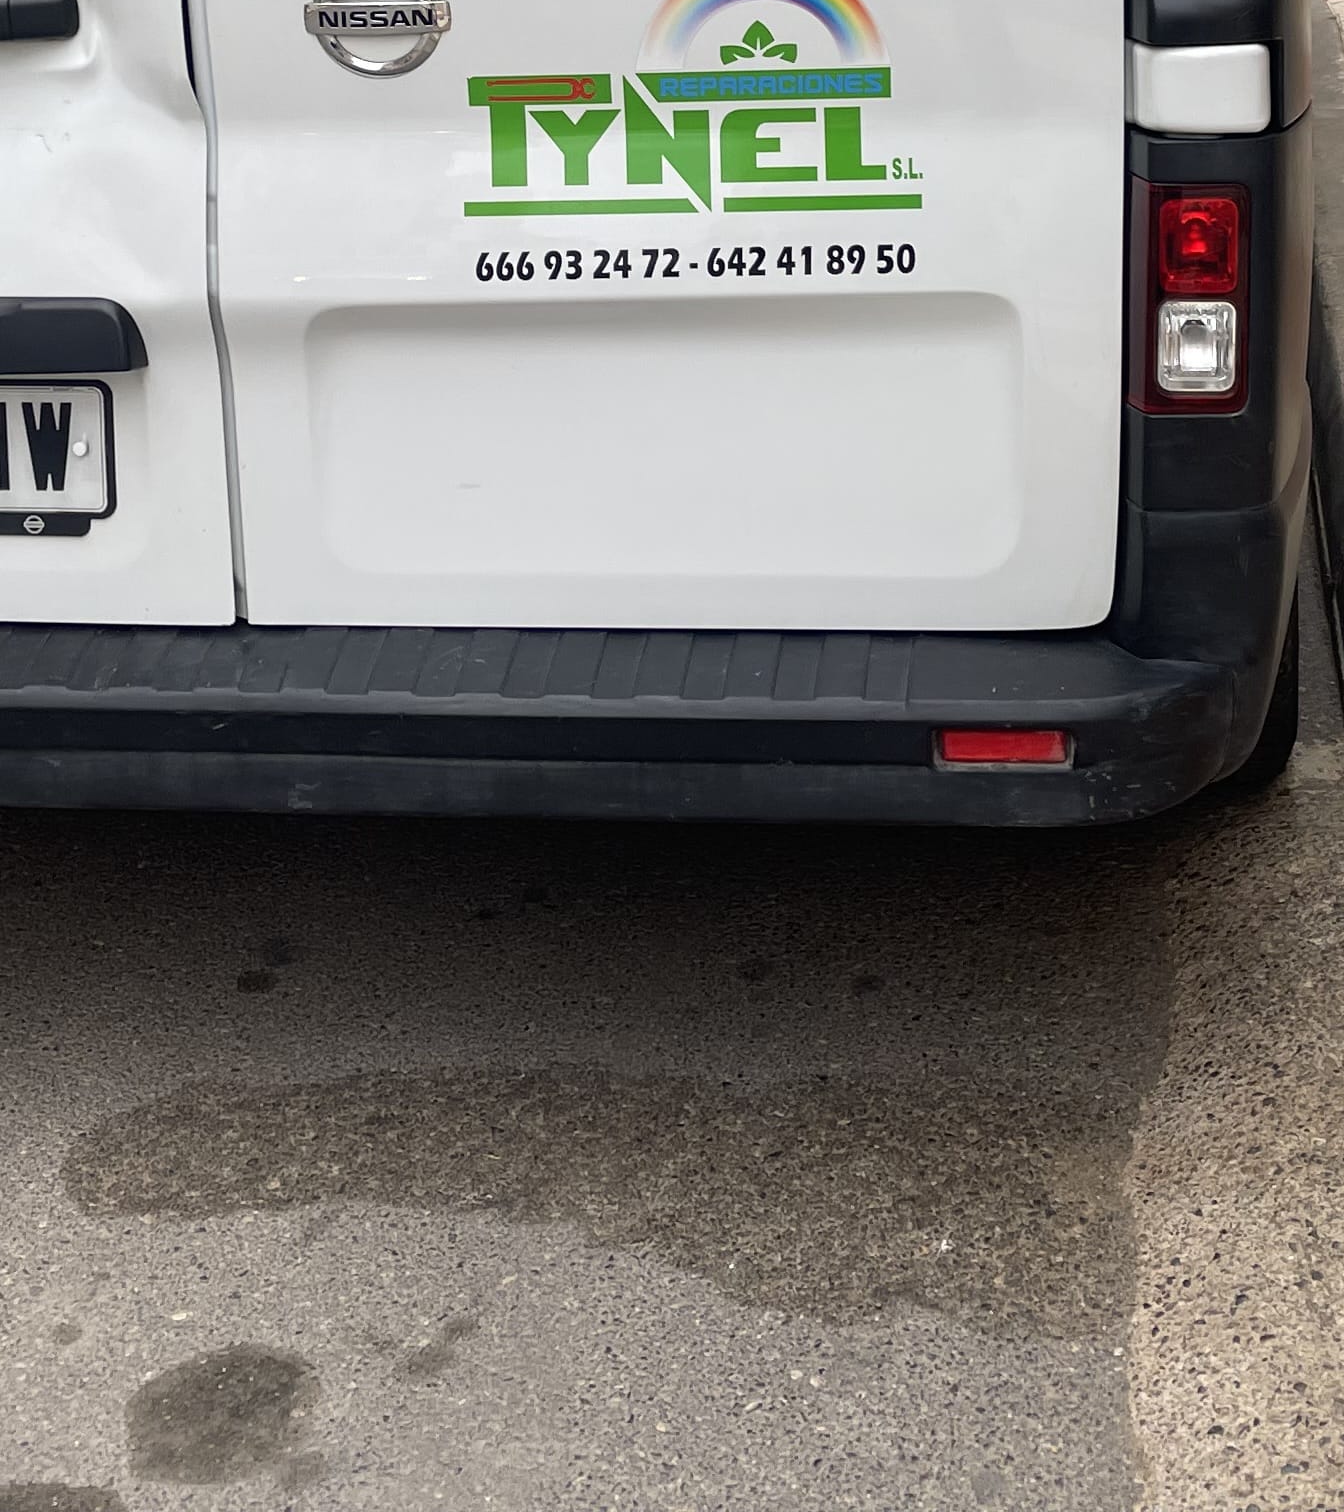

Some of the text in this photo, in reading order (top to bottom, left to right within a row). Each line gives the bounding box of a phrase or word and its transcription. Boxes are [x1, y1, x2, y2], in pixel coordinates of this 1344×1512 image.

[318, 9, 434, 28] NISSAN
[660, 74, 882, 97] REPARACIONES
[467, 74, 924, 212] TYNEL S.L.
[475, 251, 535, 282] 666
[544, 250, 583, 280] 93
[593, 249, 632, 279] 24
[642, 248, 680, 278] 72
[707, 246, 766, 278] 642
[776, 245, 812, 276] 41
[826, 244, 866, 275] 89
[876, 243, 916, 274] 50
